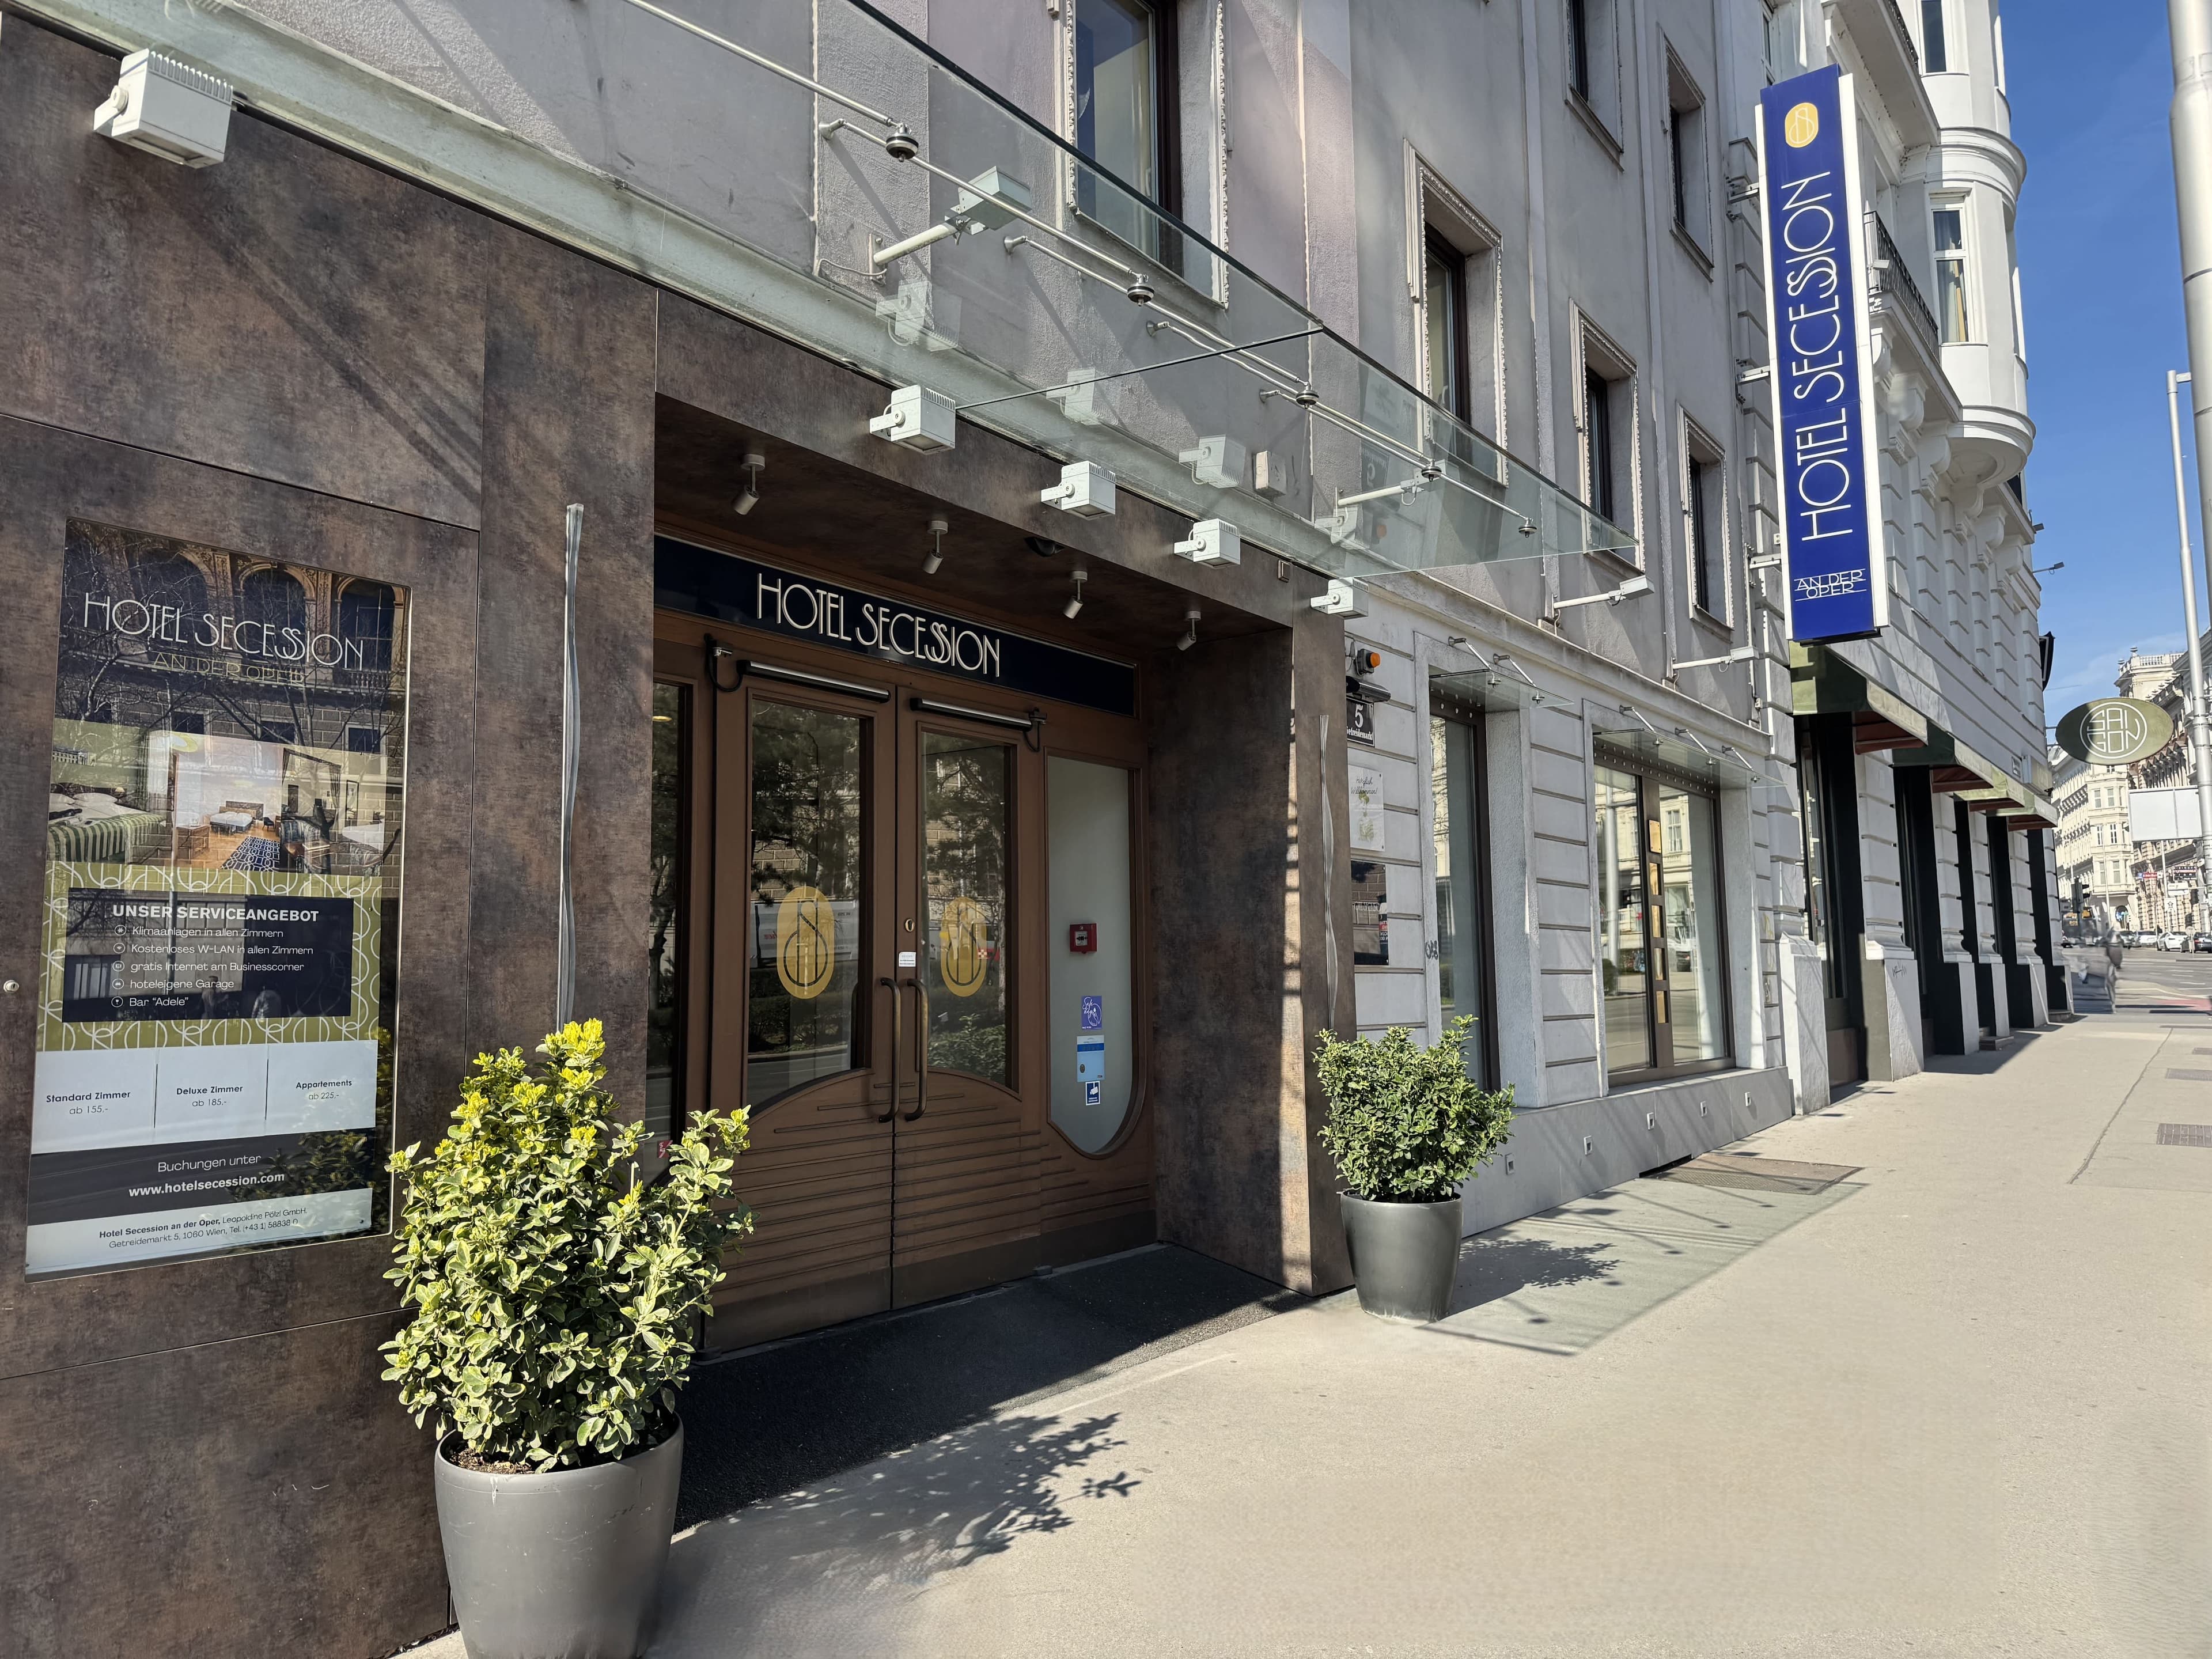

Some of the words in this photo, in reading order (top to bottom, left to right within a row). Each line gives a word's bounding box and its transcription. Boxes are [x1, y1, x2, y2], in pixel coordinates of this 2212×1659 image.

[1781, 172, 1844, 403] SECESSION
[1796, 408, 1853, 541] HOTEL
[1797, 576, 1821, 590] AN
[1828, 570, 1864, 585] DER
[1806, 582, 1855, 599] OPER
[84, 592, 188, 643] HOTEL
[195, 613, 363, 671] SECESSION
[757, 573, 852, 641] HOTEL
[855, 604, 999, 677] SECESSION
[153, 652, 186, 671] AN
[196, 658, 241, 679] DER
[246, 666, 306, 687] OPER
[1355, 703, 1363, 728] 5
[113, 904, 172, 918] UNSER
[176, 906, 319, 922] SERVICEANGEBOT
[132, 926, 201, 938] Klimaanlagen
[204, 927, 213, 936] in
[215, 927, 238, 937] allen
[241, 929, 284, 938] Zimmern
[131, 944, 195, 954] Kostenloses
[198, 945, 234, 954] W-LAN
[237, 945, 245, 954] in
[247, 945, 270, 954] allen
[272, 946, 313, 955] Zimmern
[130, 962, 162, 972] gratis
[165, 962, 209, 971] Internet
[230, 963, 305, 971] Businesscorner
[130, 980, 193, 990] hoteleigene
[195, 979, 234, 990] Garage
[129, 997, 149, 1006] Bar
[296, 1080, 352, 1090] Appartements
[46, 1093, 92, 1103] Standard
[95, 1092, 131, 1100] Zimmer
[209, 1098, 227, 1106] 185,-
[69, 1107, 83, 1115] ab
[87, 1105, 109, 1114] 155,-
[158, 1158, 226, 1172] Buchungen
[229, 1155, 262, 1166] unter
[128, 1173, 285, 1197] www.hotelsecession.com
[99, 1229, 123, 1238] Hotel
[125, 1224, 168, 1235] Secession
[199, 1218, 221, 1227] Oper,
[222, 1213, 263, 1224] Leopoldine
[264, 1210, 281, 1218] Pölzl
[282, 1207, 307, 1216] GmbH.
[109, 1234, 172, 1248] Getreidemarkt
[173, 1233, 180, 1241] 5,
[182, 1230, 204, 1240] 1060
[243, 1223, 259, 1233] (+43
[260, 1222, 266, 1230] 1)
[267, 1219, 291, 1229] 58838
